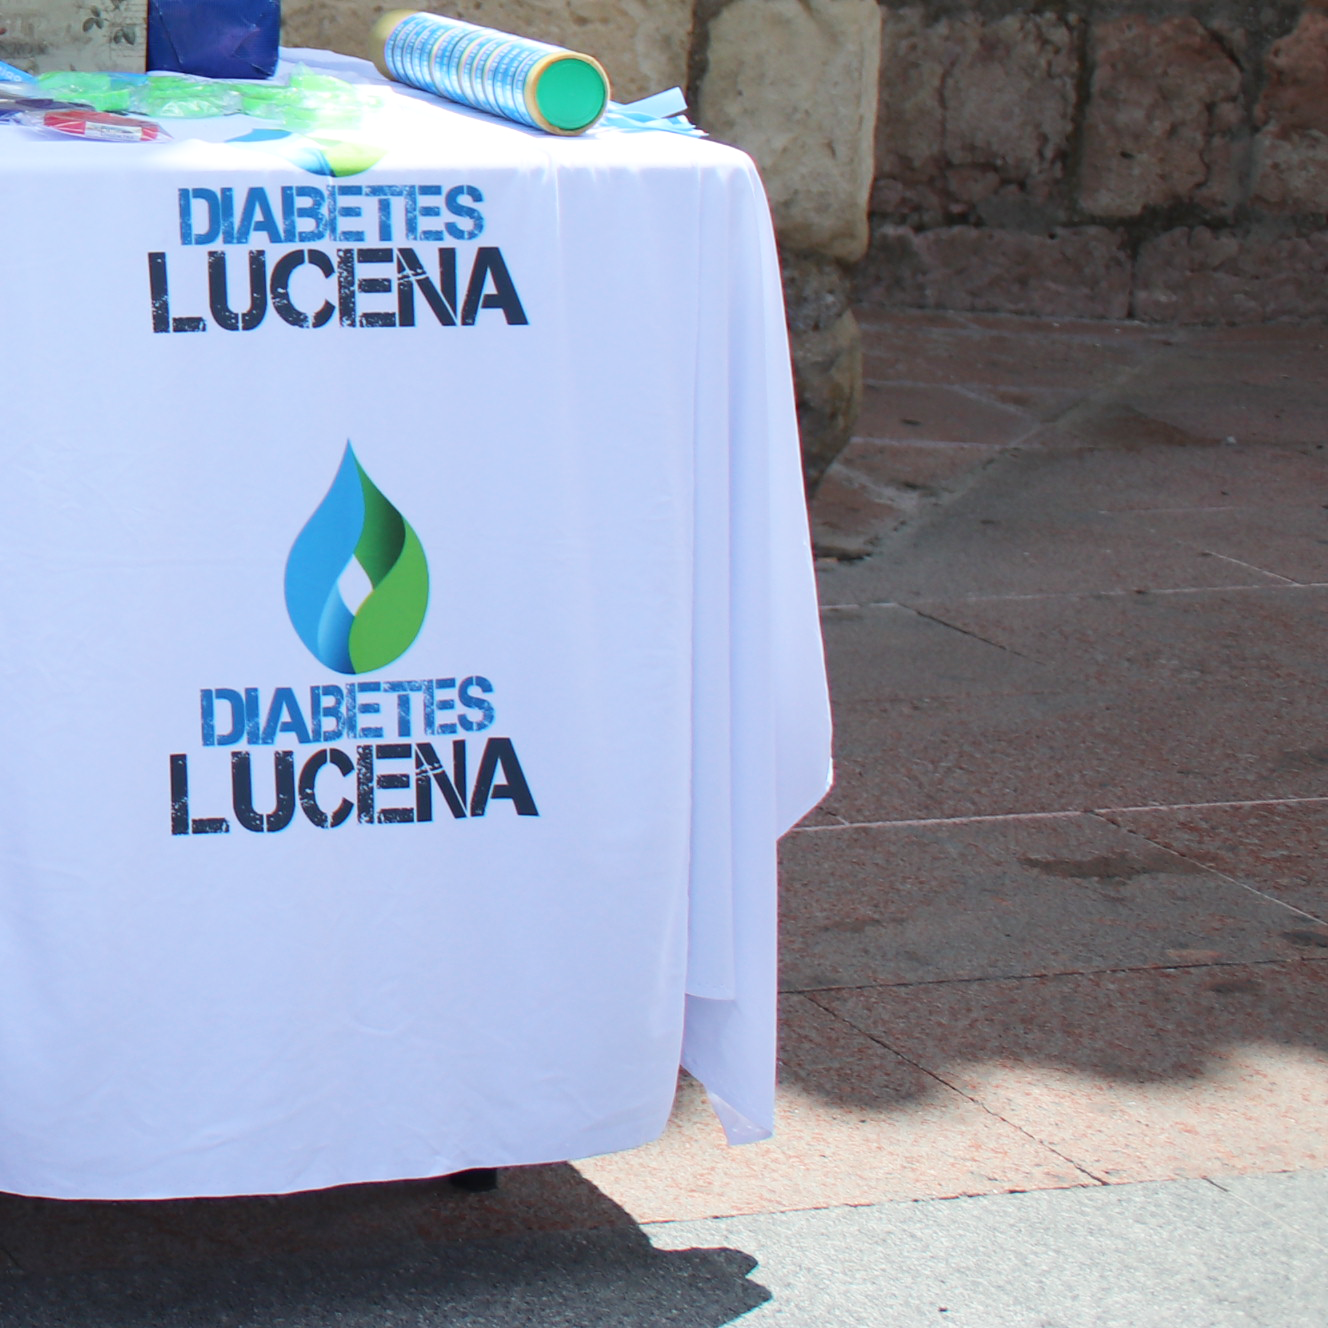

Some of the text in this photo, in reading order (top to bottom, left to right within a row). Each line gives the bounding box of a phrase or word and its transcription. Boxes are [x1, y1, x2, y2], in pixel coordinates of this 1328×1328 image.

[178, 184, 486, 246] DIABETES
[147, 246, 529, 333] LUCENA
[200, 675, 495, 747] DIABETES
[169, 736, 540, 835] LUCENA
